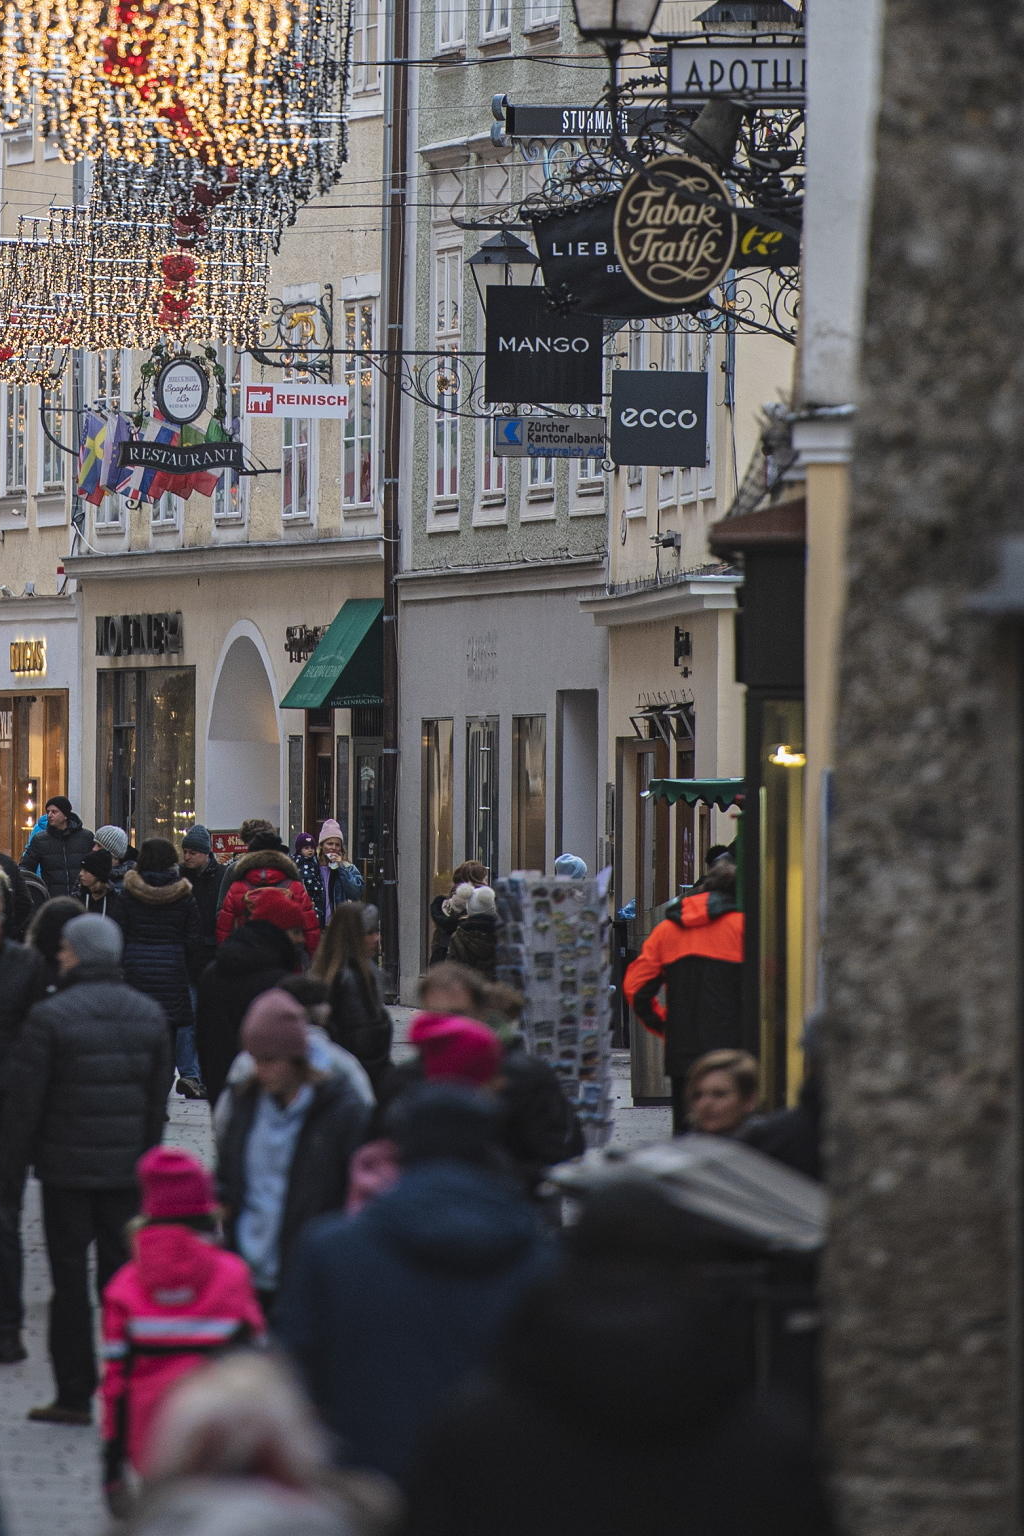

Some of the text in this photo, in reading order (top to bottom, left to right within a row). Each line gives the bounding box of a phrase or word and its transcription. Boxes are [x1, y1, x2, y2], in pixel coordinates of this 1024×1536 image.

[627, 189, 723, 228] Tabak
[552, 242, 618, 256] LIEB
[628, 226, 723, 267] Trafik
[499, 336, 590, 353] MANGO
[165, 383, 201, 395] Spaghetti
[276, 394, 348, 407] REINISCH
[621, 407, 698, 429] ecco
[528, 421, 570, 433] Zürcher
[528, 432, 605, 445] Kantonalbank
[129, 446, 238, 468] RESTAURANT
[527, 445, 605, 457] Österreich AG
